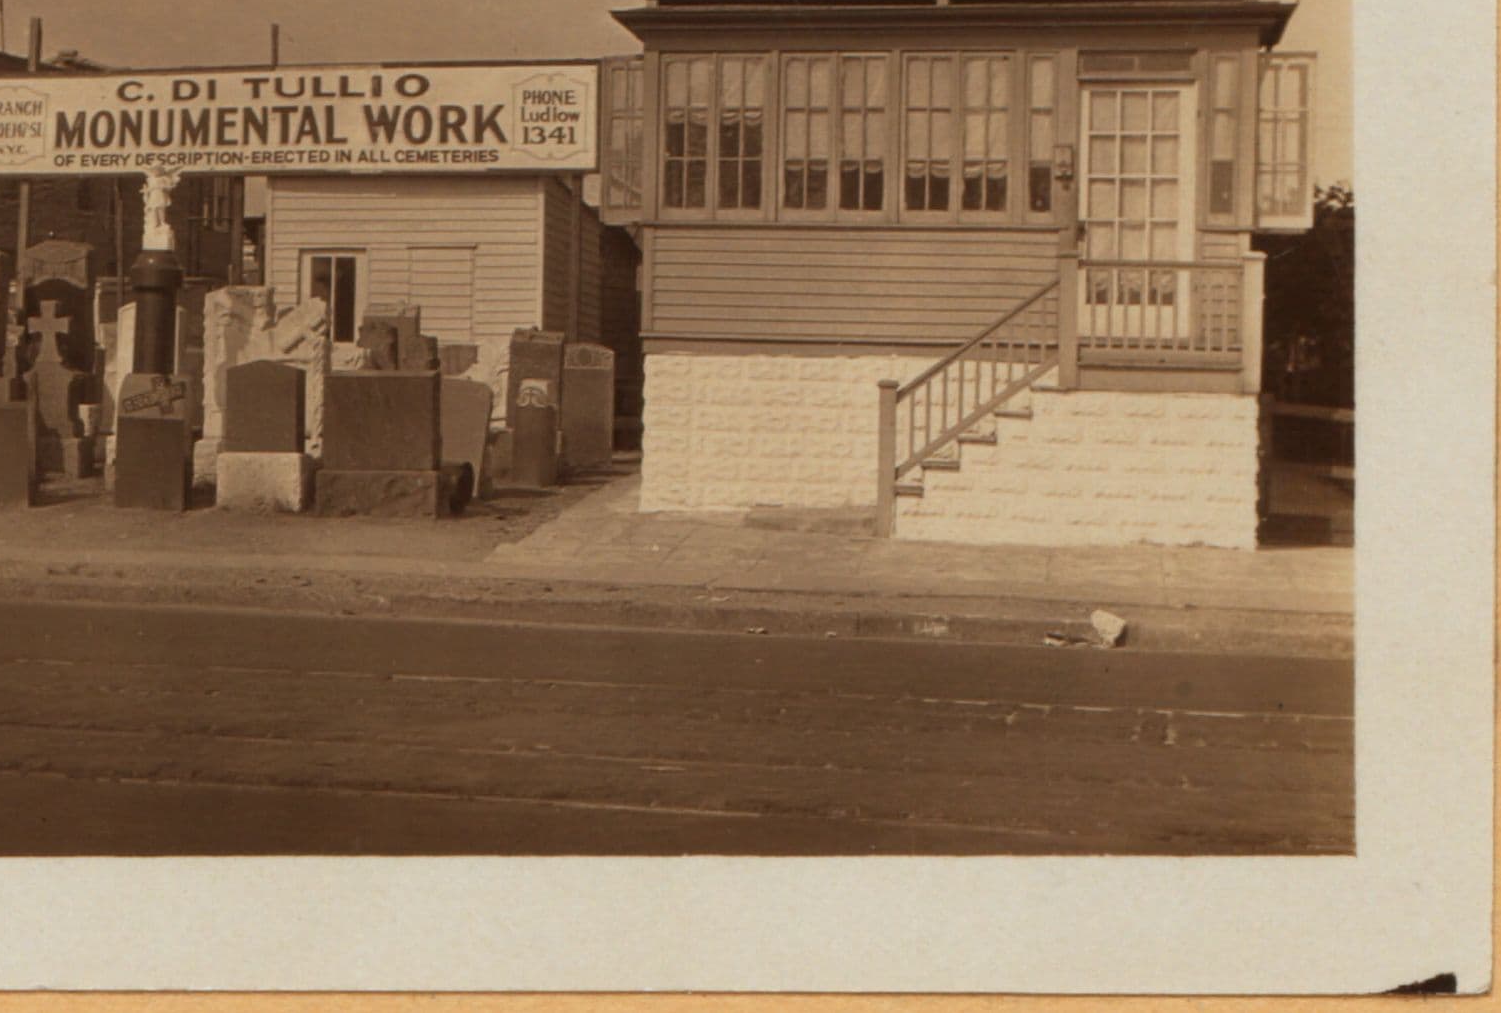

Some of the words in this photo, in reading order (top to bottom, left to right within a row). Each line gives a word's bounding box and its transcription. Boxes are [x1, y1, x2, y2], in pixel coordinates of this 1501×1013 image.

[116, 80, 155, 102] C.
[171, 79, 217, 101] DI
[242, 73, 431, 100] TULLIO
[522, 90, 577, 105] PHONE
[521, 106, 580, 122] Ludlow
[54, 104, 349, 148] MONUMENTAL
[362, 104, 509, 145] WORK
[522, 126, 577, 145] 1341
[53, 154, 76, 167] OF
[80, 153, 130, 167] EVERY
[335, 149, 351, 163] IN
[357, 149, 390, 163] ALL
[394, 149, 499, 163] CEMETERIES
